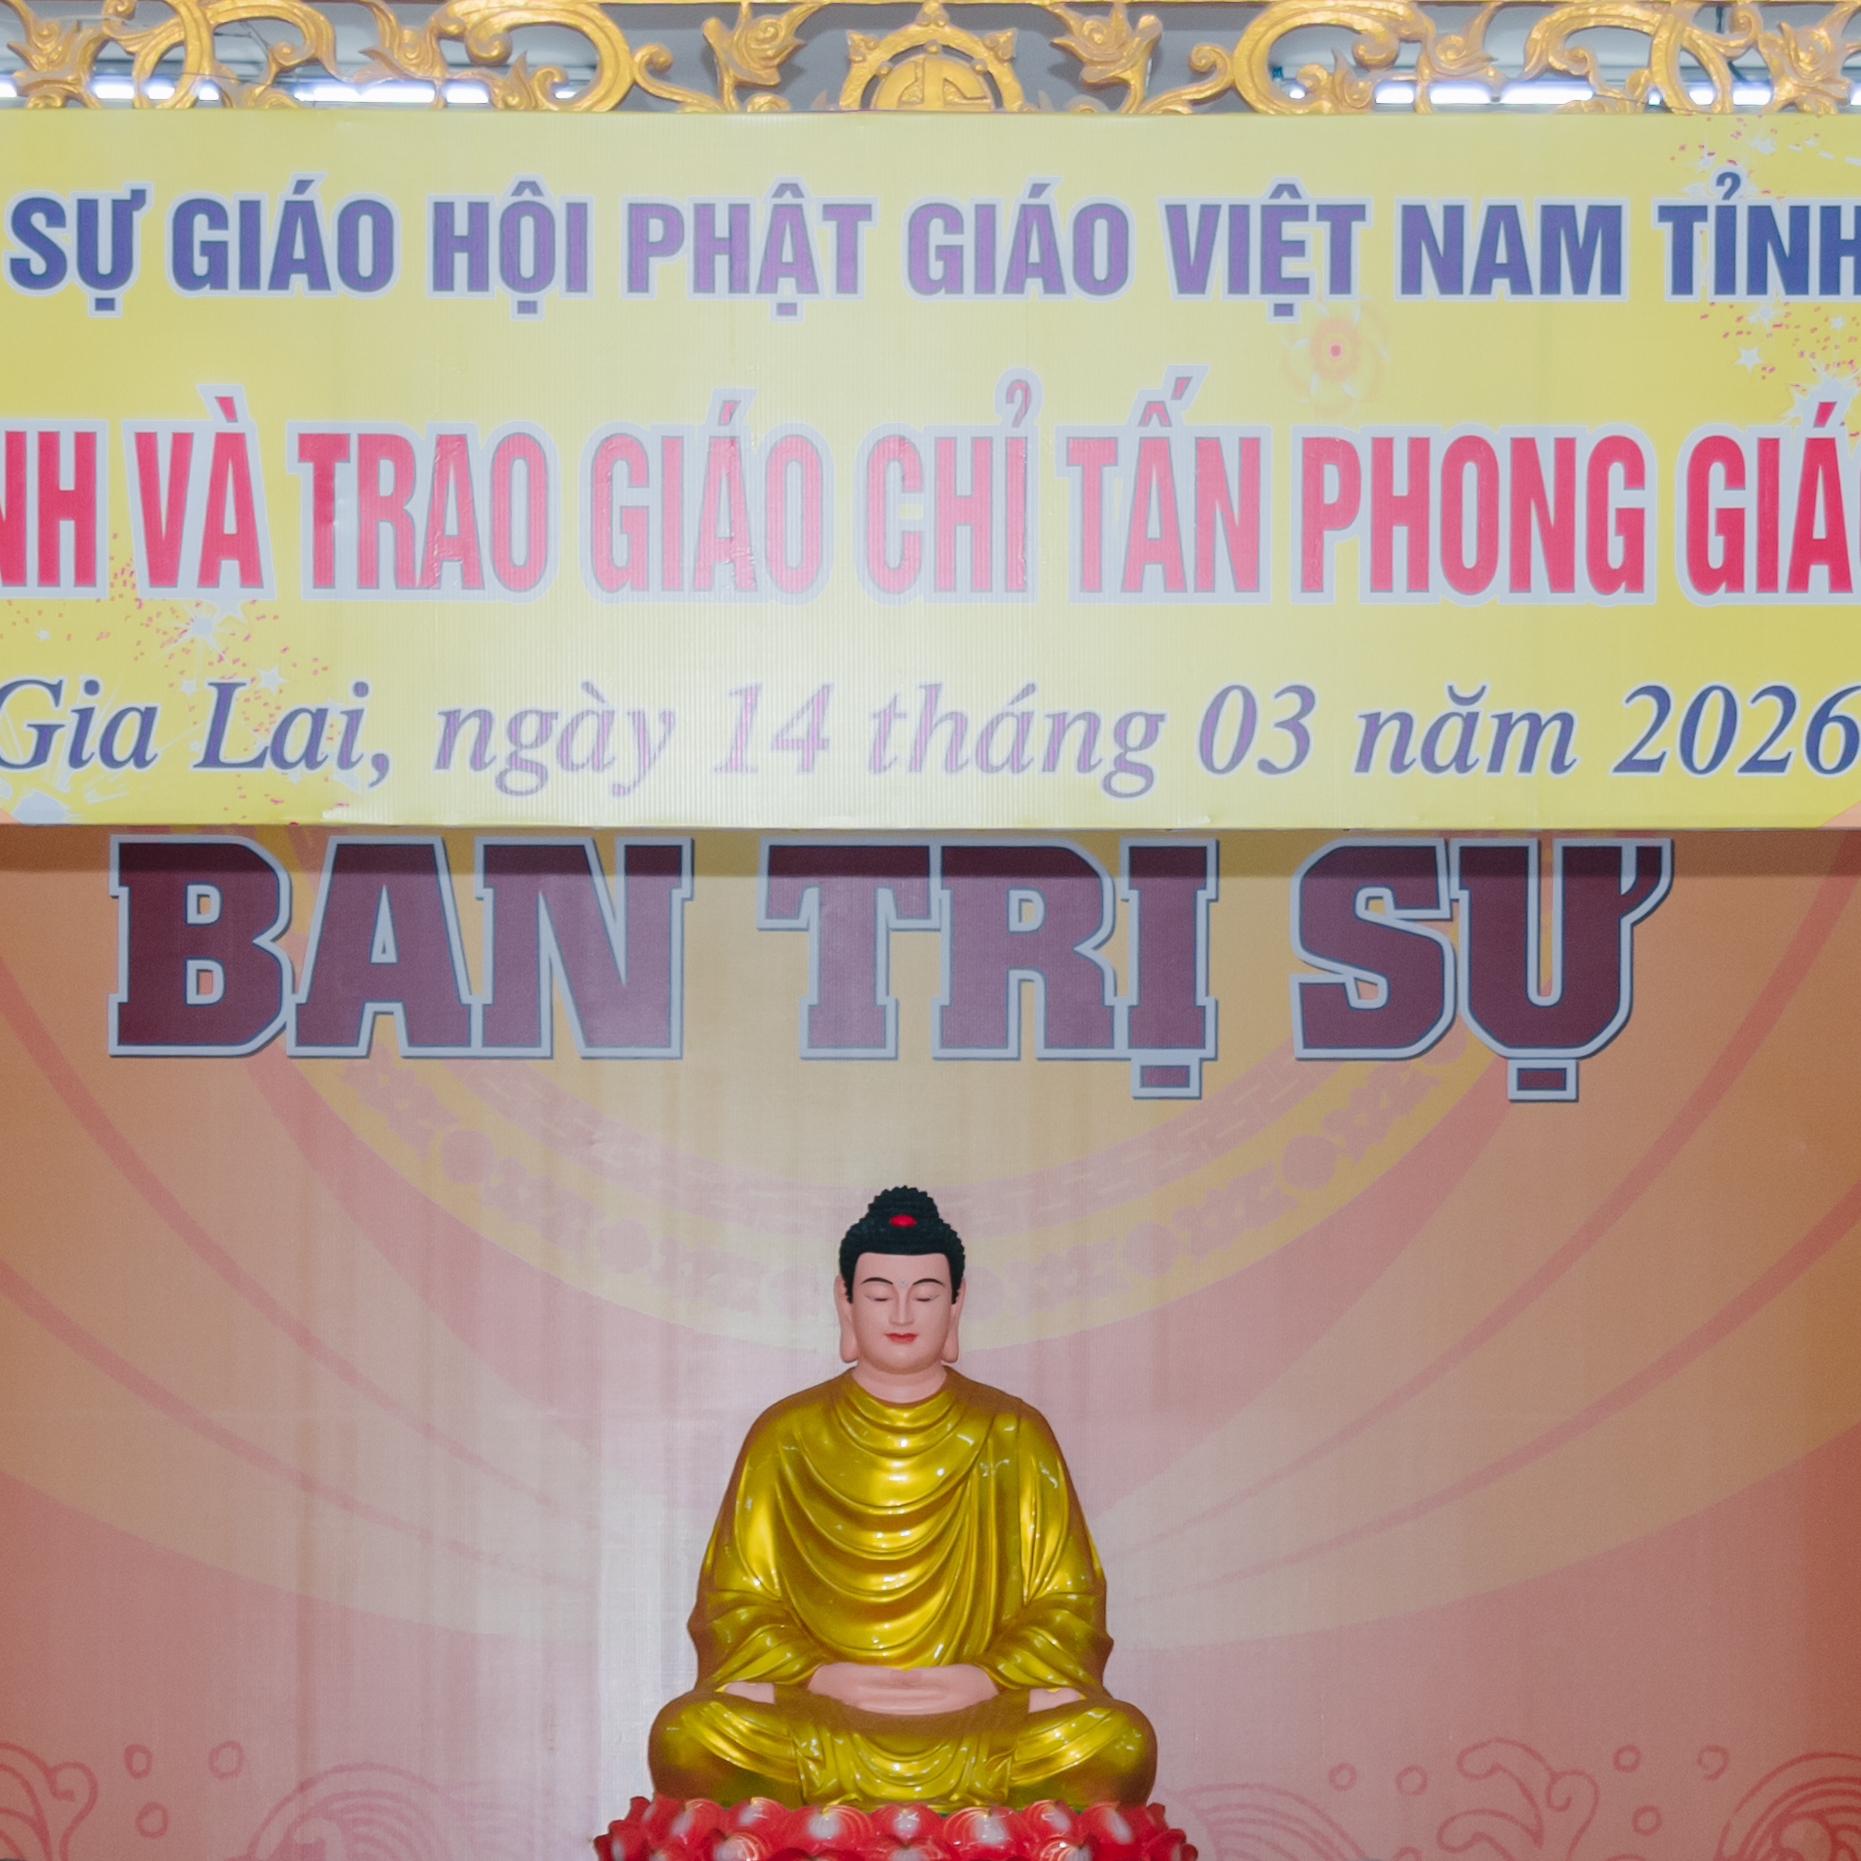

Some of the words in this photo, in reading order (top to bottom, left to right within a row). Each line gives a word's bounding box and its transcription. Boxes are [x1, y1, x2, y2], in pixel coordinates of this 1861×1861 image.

[9, 187, 150, 312] SỰ
[171, 179, 396, 293] GIÁO
[432, 181, 590, 317] HỘI
[628, 181, 874, 317] PHẬT
[906, 182, 1131, 296] GIÁO
[1163, 183, 1368, 318] VIỆT
[1397, 202, 1624, 296] NAM
[138, 395, 266, 592] VÀ
[296, 432, 547, 594] TRAO
[591, 399, 827, 594] GIÁO
[865, 378, 1032, 594] CHỈ
[1066, 375, 1263, 594] TẤN
[1299, 433, 1647, 595] PHONG
[193, 680, 394, 792] Lai,
[435, 680, 678, 798] ngày
[713, 682, 833, 774] 14
[868, 682, 1168, 798] tháng
[1196, 683, 1319, 775] 03
[1353, 684, 1579, 775] năm
[109, 837, 694, 1060] BAN
[757, 836, 1221, 1102] TRỊ
[1290, 836, 1674, 1103] SỰ
